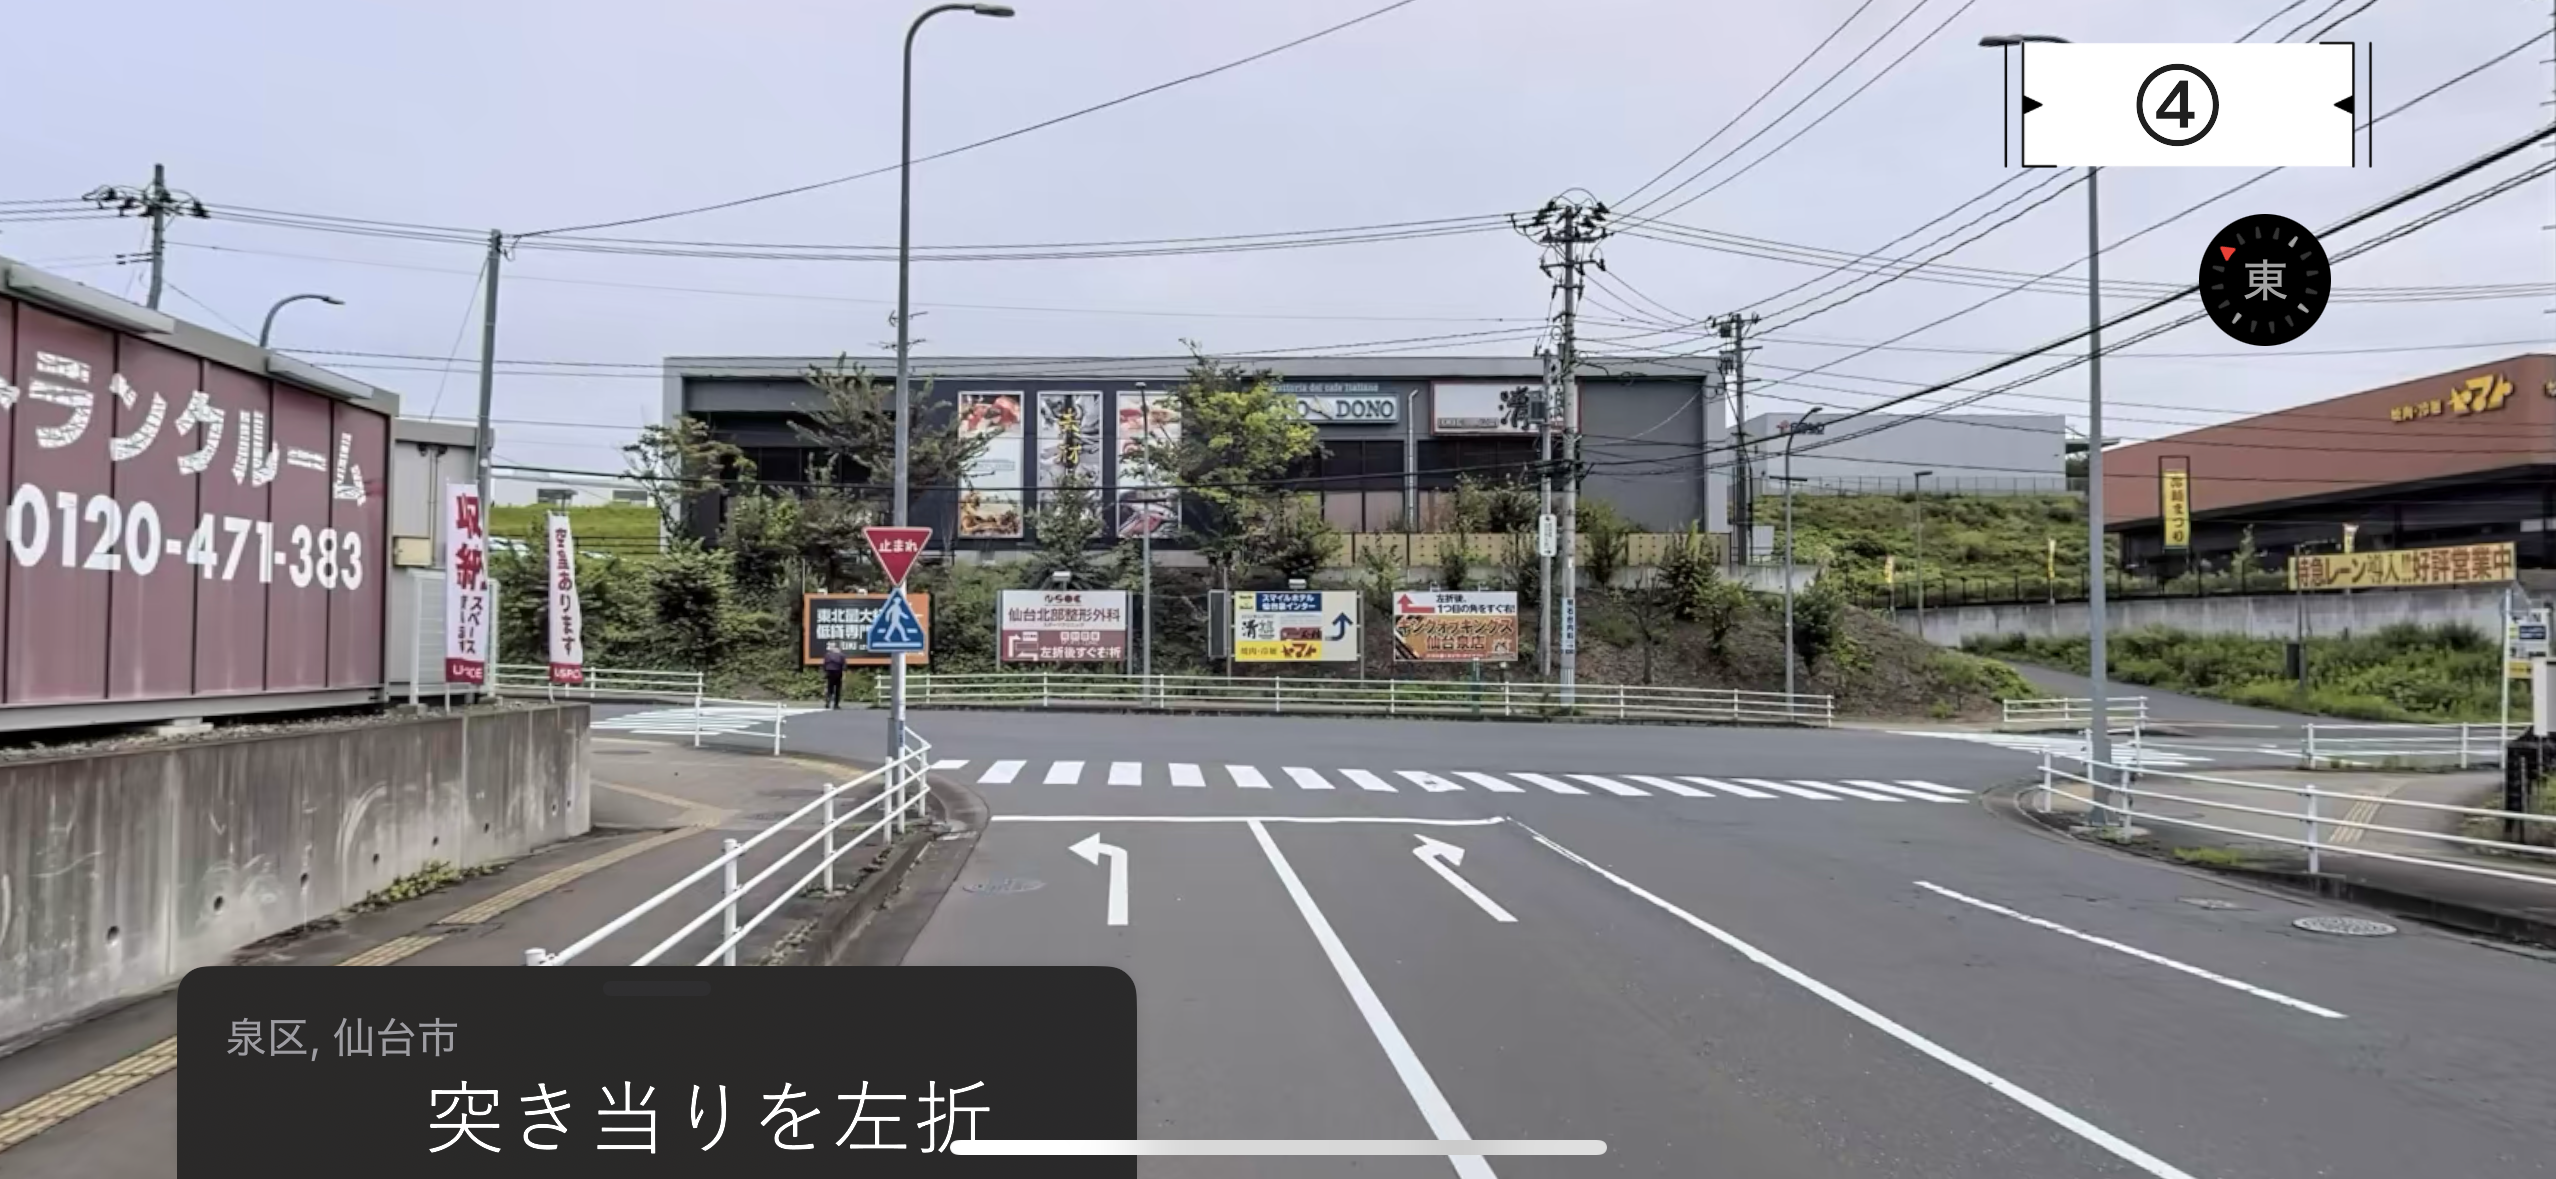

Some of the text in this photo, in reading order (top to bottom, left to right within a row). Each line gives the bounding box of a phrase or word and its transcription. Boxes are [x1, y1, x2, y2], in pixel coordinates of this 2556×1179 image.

[2449, 373, 2514, 413] ヤマト
[1335, 399, 1394, 418] DONO
[6, 482, 363, 591] 0120-471-383
[456, 493, 488, 592] 収納
[878, 538, 919, 553] 止まれ
[1262, 594, 1315, 602] スマイルホテル
[1008, 607, 1120, 622] 仙台北部整形外科
[467, 596, 484, 655] スペース
[1426, 635, 1486, 650] 仙台泉店
[1040, 646, 1121, 659] 左折後すぐ右折
[1281, 643, 1317, 658] ヤマト
